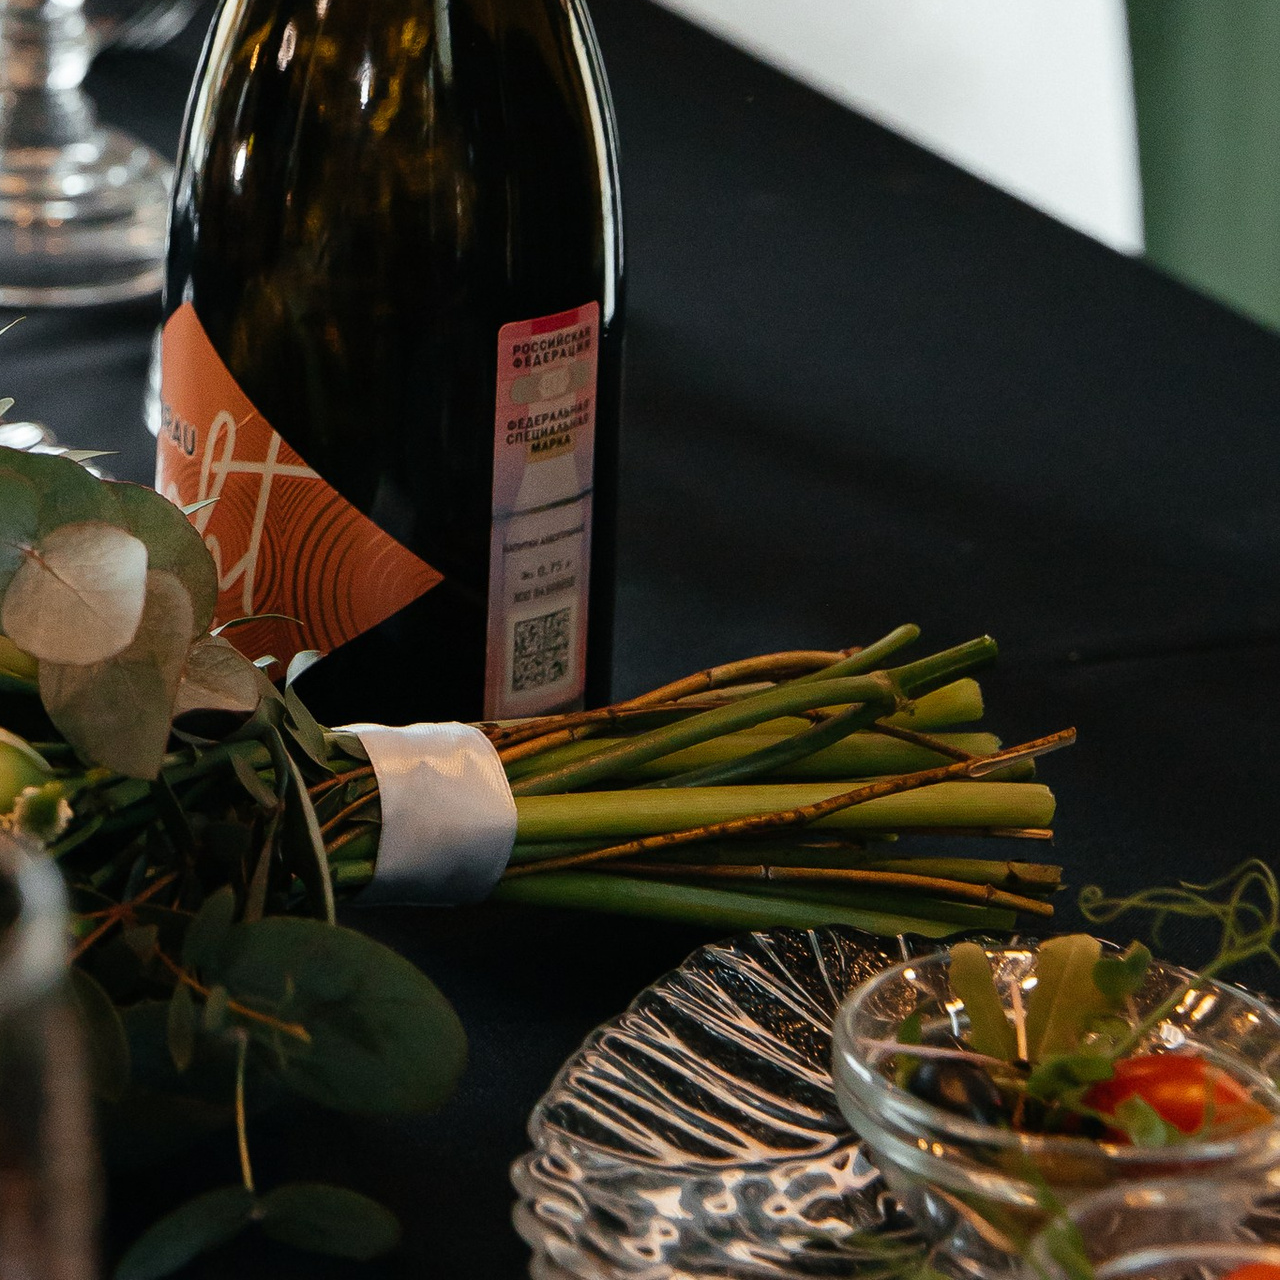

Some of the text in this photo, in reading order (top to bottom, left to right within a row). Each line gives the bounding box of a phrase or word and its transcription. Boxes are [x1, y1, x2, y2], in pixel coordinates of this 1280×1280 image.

[513, 326, 591, 356] РОССИЙСКАЯ
[513, 339, 591, 368] ФЕДЕРАЦИЯ
[506, 413, 590, 445] СПЕЦИАЛЬНАЯ
[507, 399, 590, 430] ФЕДЕРАЛЬНАЯ
[530, 434, 572, 453] МАРКА
